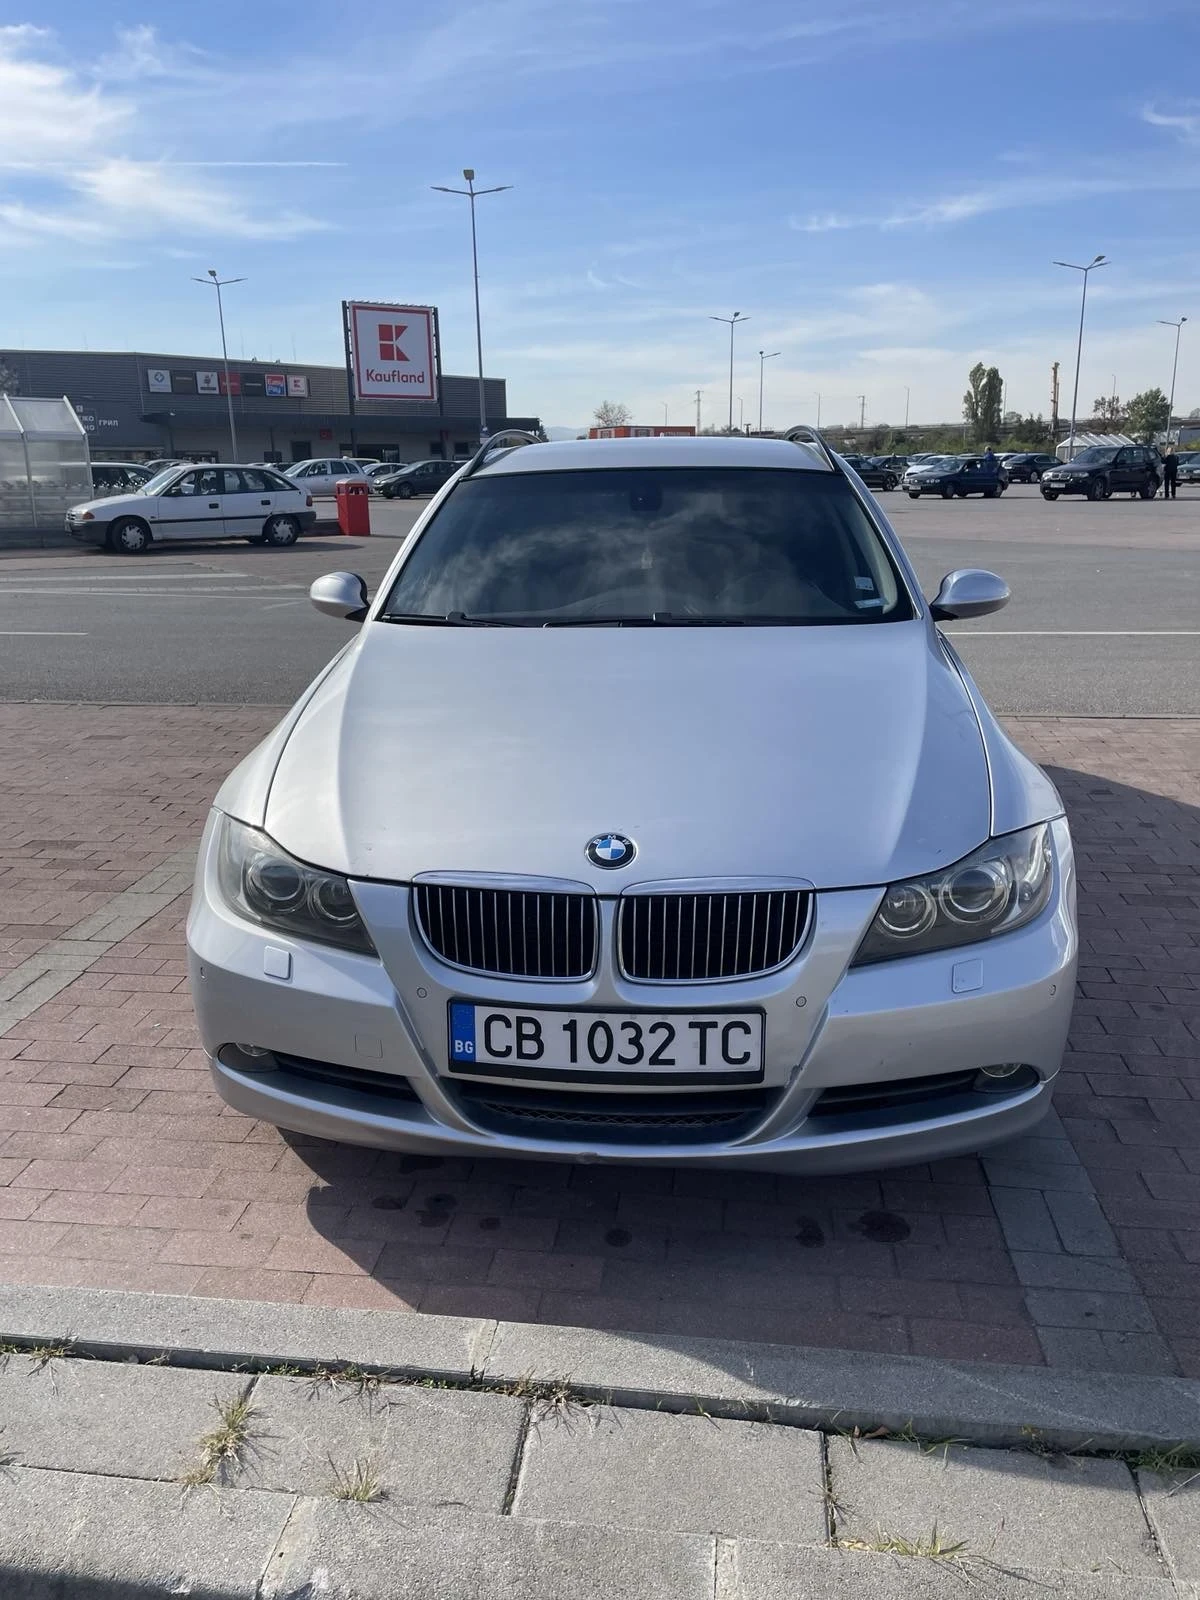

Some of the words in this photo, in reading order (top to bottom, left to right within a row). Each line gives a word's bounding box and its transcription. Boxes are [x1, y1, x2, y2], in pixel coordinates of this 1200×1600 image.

[366, 369, 425, 383] Kaufland
[454, 1039, 474, 1055] BG
[484, 1014, 545, 1060] CB
[562, 1018, 676, 1066] 1032
[688, 1021, 751, 1066] TC
